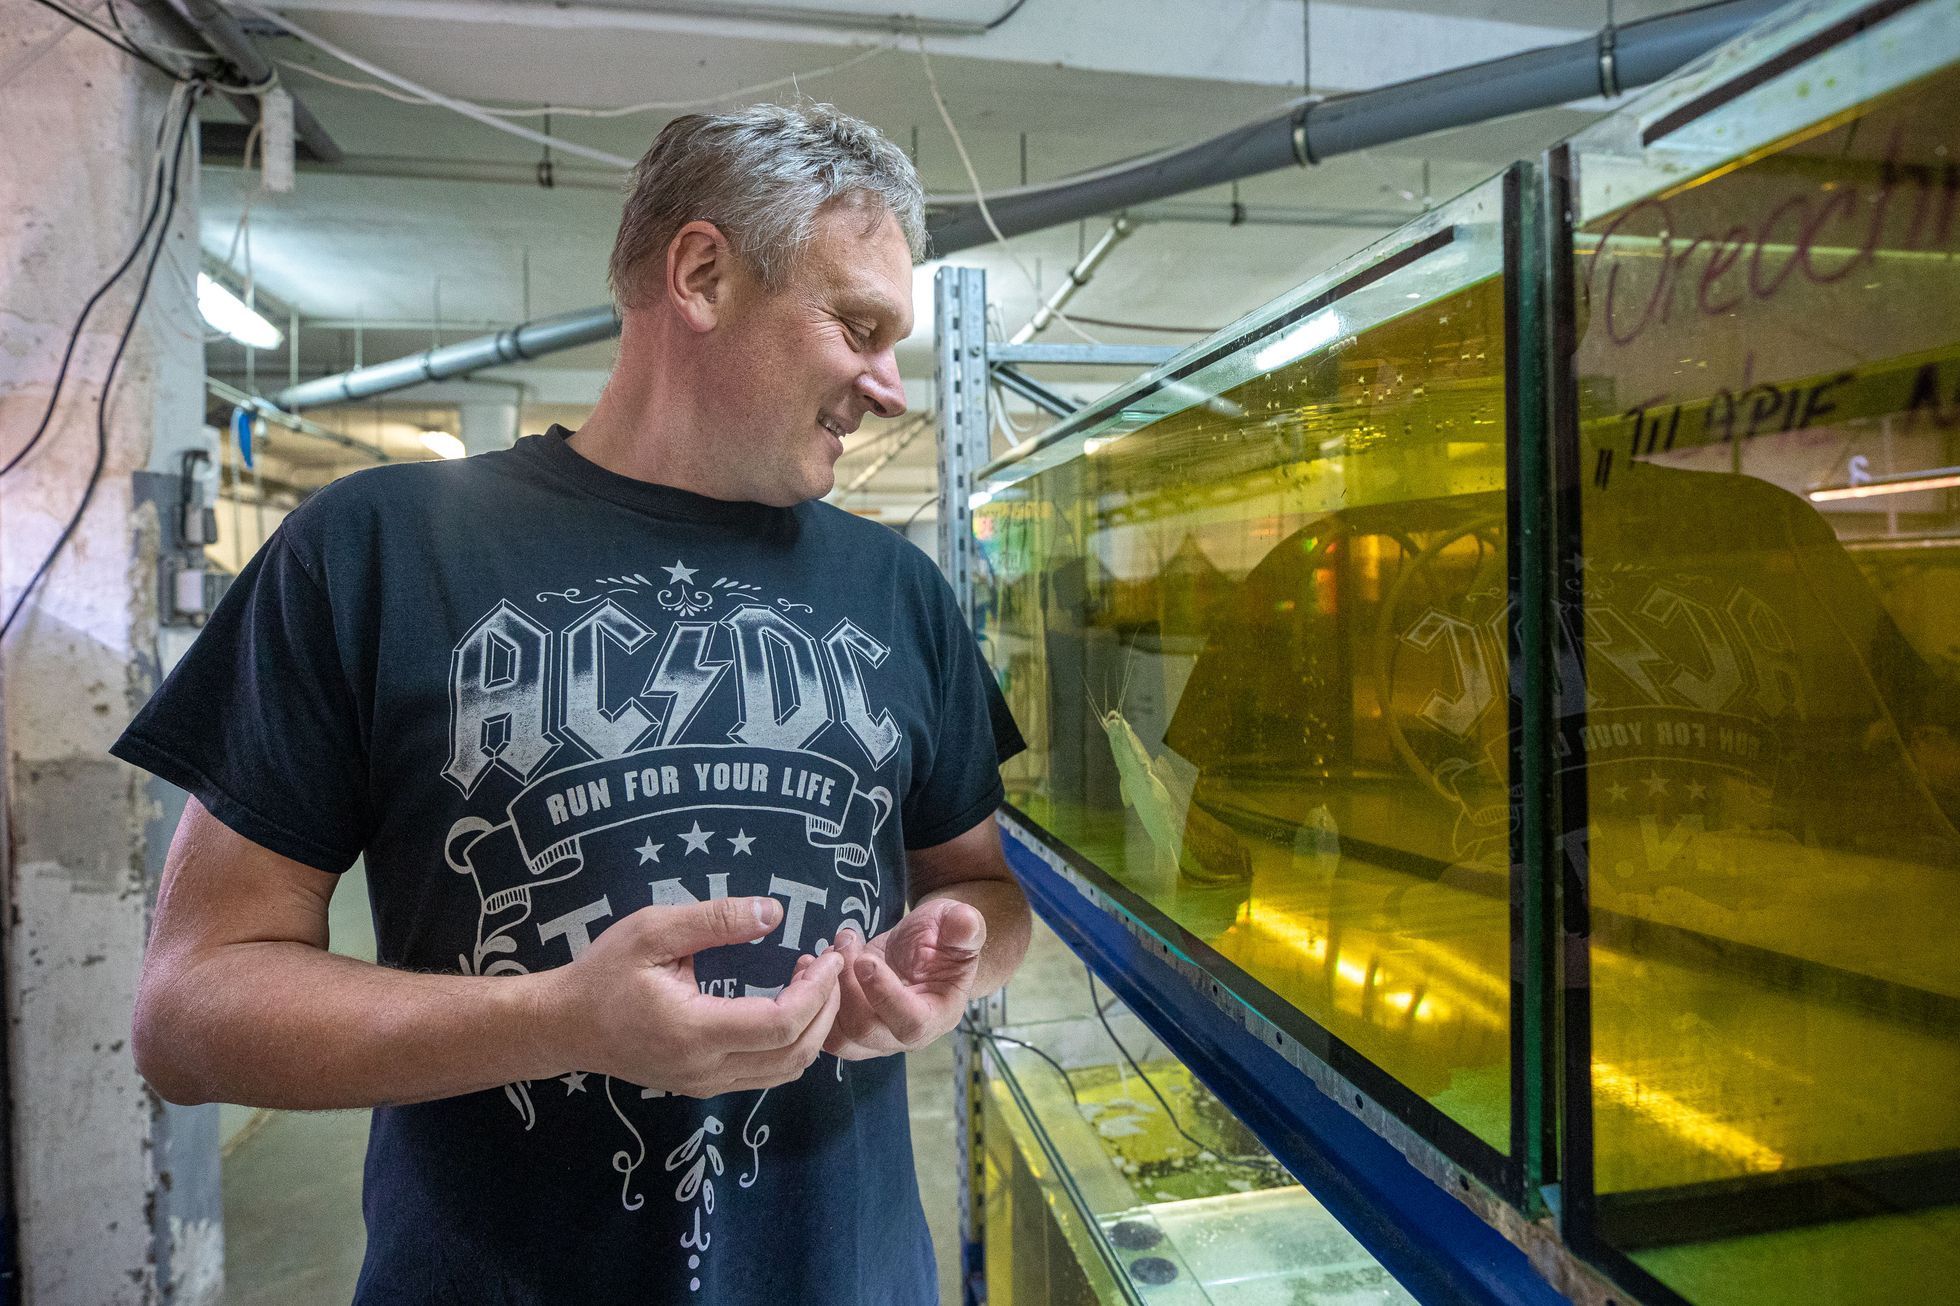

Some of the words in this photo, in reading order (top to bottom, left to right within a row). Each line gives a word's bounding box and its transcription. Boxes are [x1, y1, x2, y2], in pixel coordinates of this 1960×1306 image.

[546, 778, 612, 826] RUN
[624, 765, 680, 802] FOR
[693, 762, 769, 792] YOUR
[780, 767, 836, 807] LIFE
